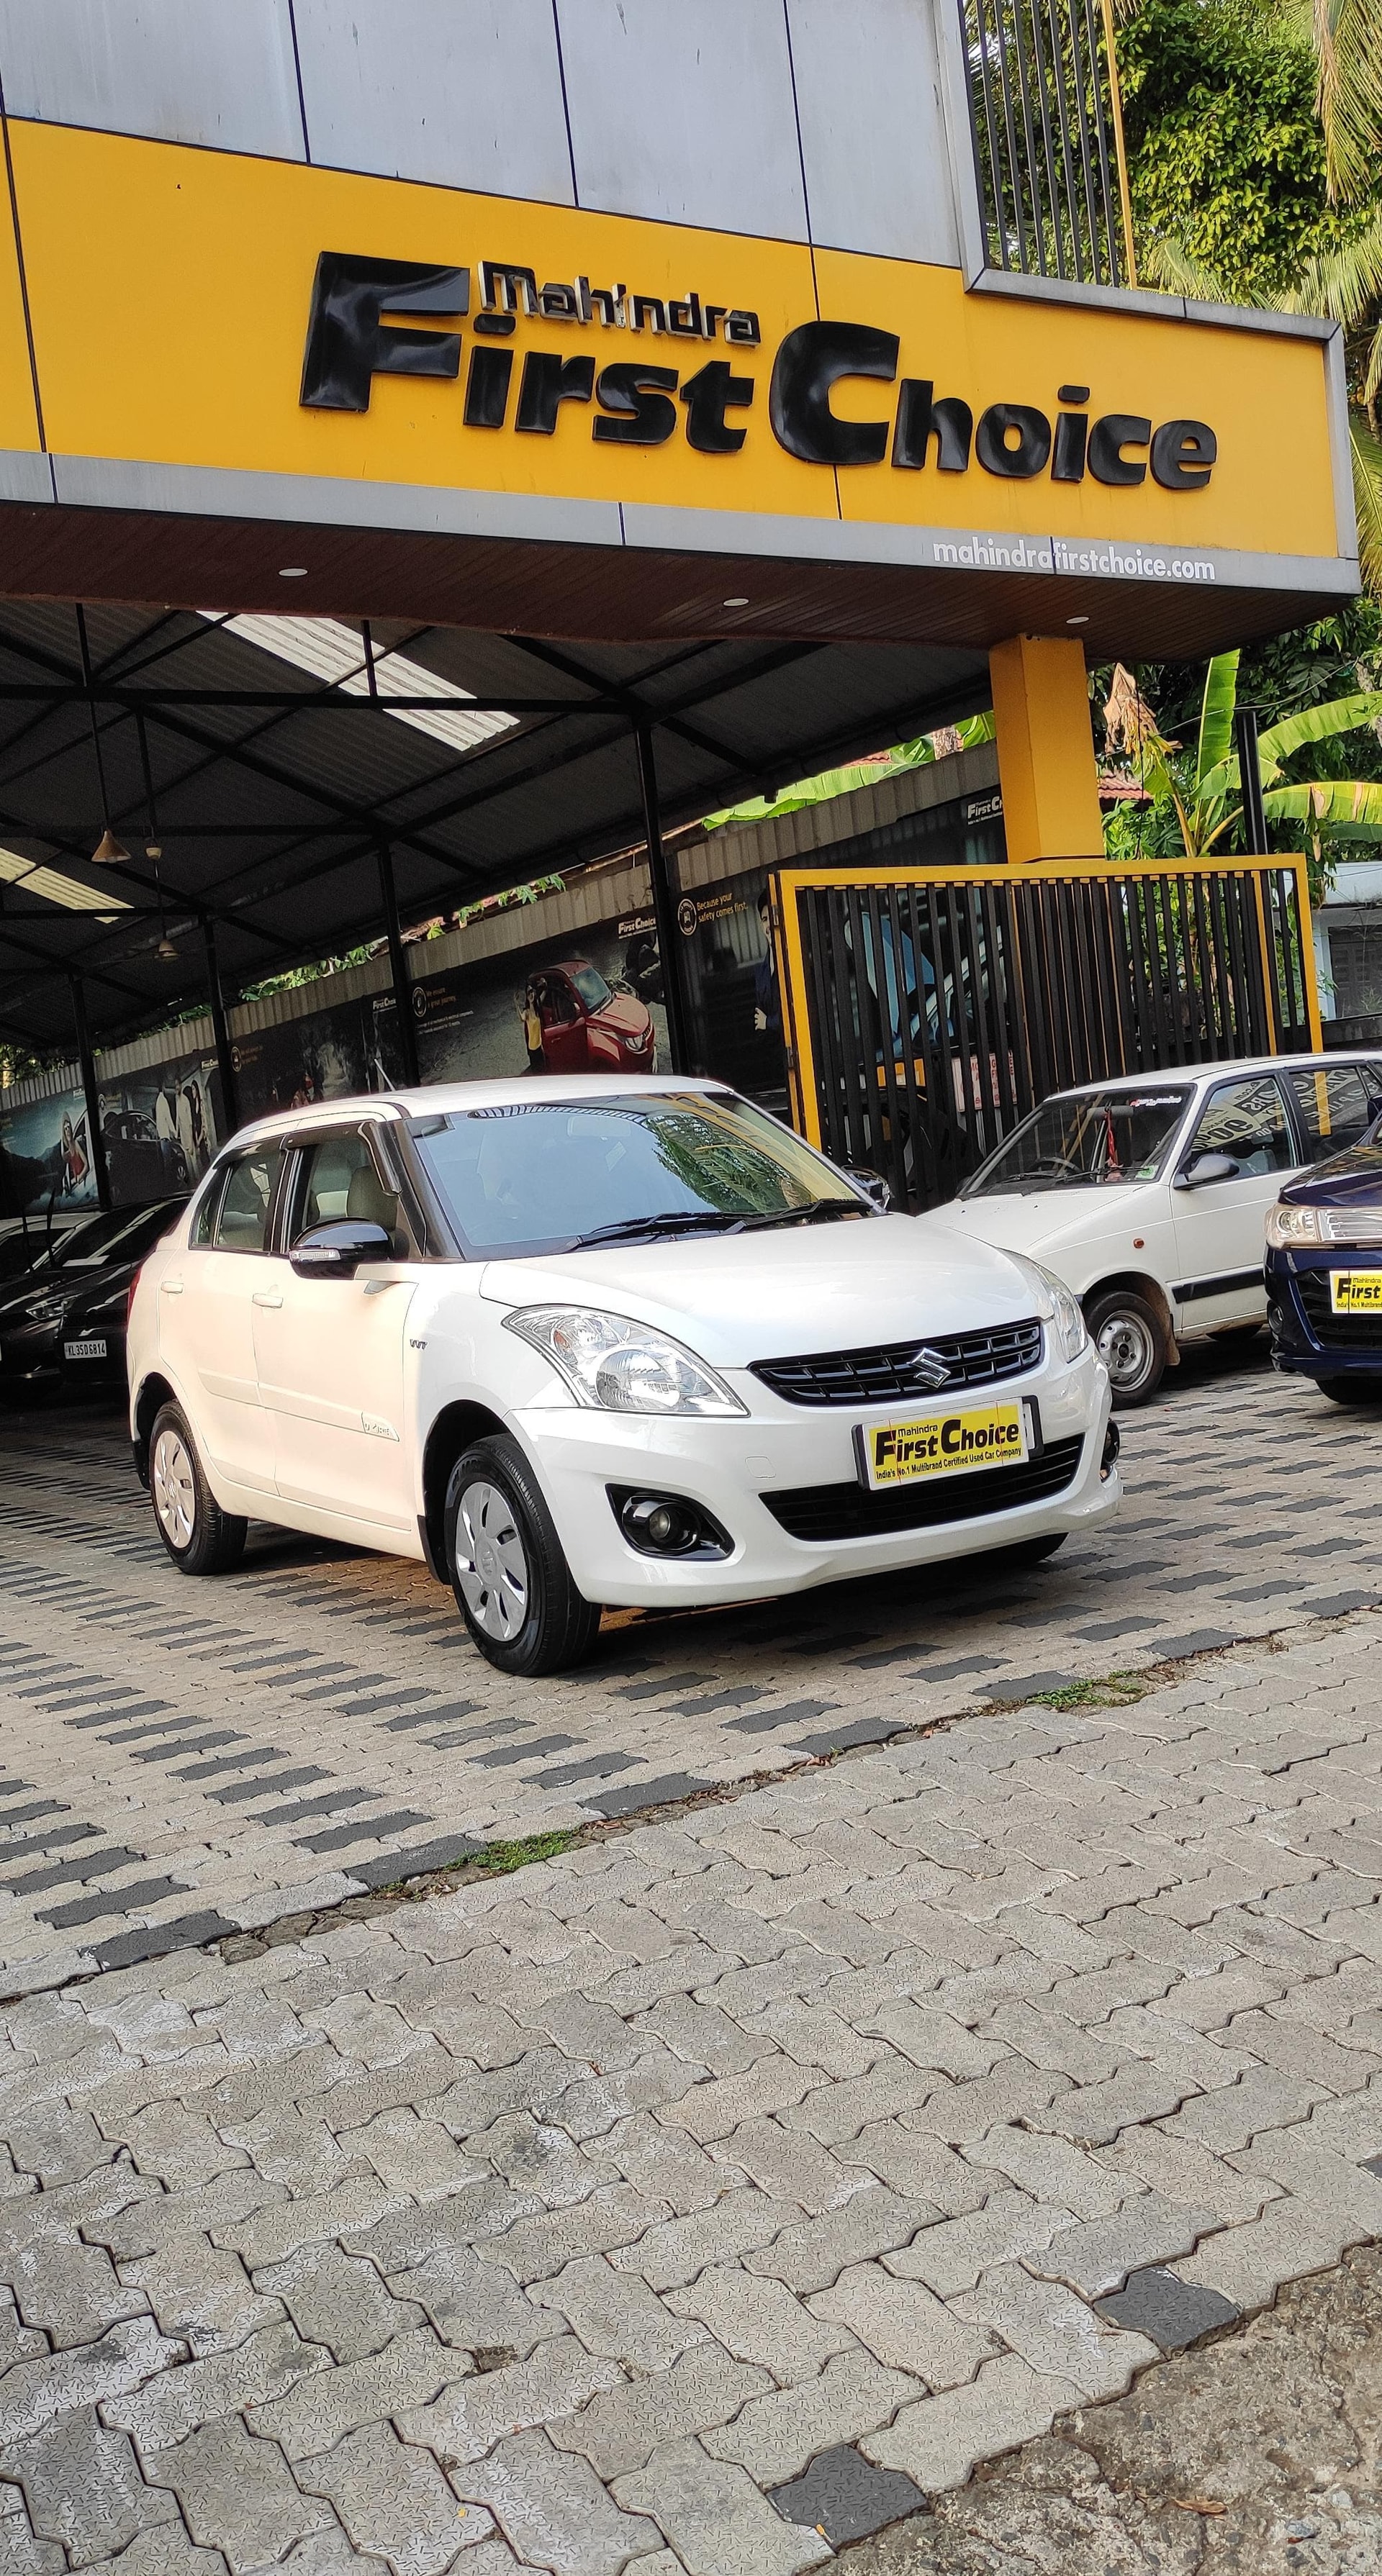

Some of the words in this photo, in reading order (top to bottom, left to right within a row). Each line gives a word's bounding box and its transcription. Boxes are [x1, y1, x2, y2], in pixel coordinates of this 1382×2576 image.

[478, 260, 762, 347] Mahindra
[933, 537, 1216, 580] mahindrafirstchoice.com
[697, 897, 719, 911] Because
[720, 893, 733, 905] your
[698, 911, 715, 922] safety
[715, 907, 733, 918] comes
[1337, 1278, 1381, 1299] First
[898, 1424, 938, 1438] Mahindra
[876, 1469, 895, 1480] India's
[911, 1460, 942, 1474] Multibrand
[943, 1456, 968, 1468] Certified
[970, 1453, 984, 1463] Used
[995, 1447, 1021, 1458] Company
